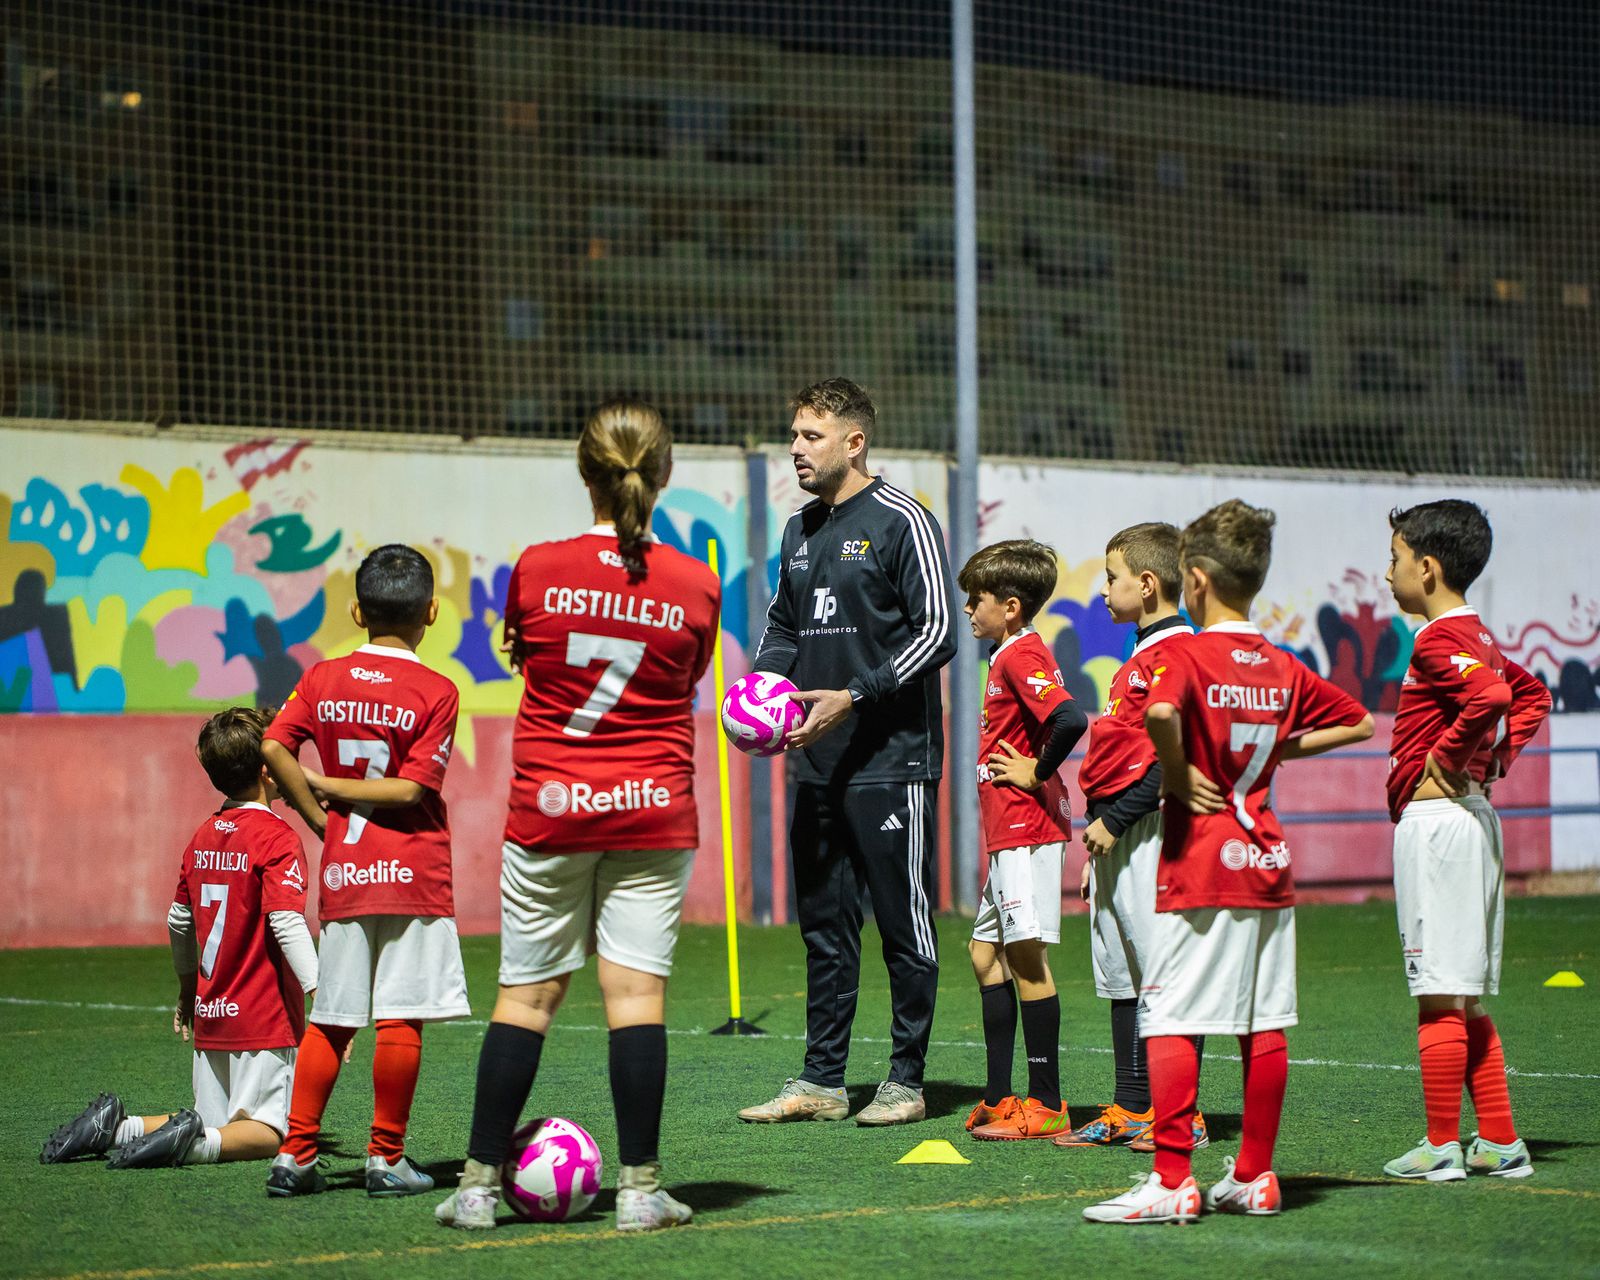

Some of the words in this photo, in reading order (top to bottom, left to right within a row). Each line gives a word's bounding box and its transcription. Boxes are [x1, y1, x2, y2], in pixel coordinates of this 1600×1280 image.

[842, 540, 870, 555] SC7
[544, 587, 685, 631] CASTILLEJO
[562, 632, 646, 737] 7
[317, 700, 416, 731] CASTILLEJO
[337, 739, 391, 844] 7
[571, 778, 671, 813] Retlife
[1230, 723, 1278, 831] 7
[343, 859, 414, 887] Retlife
[200, 884, 229, 980] 7
